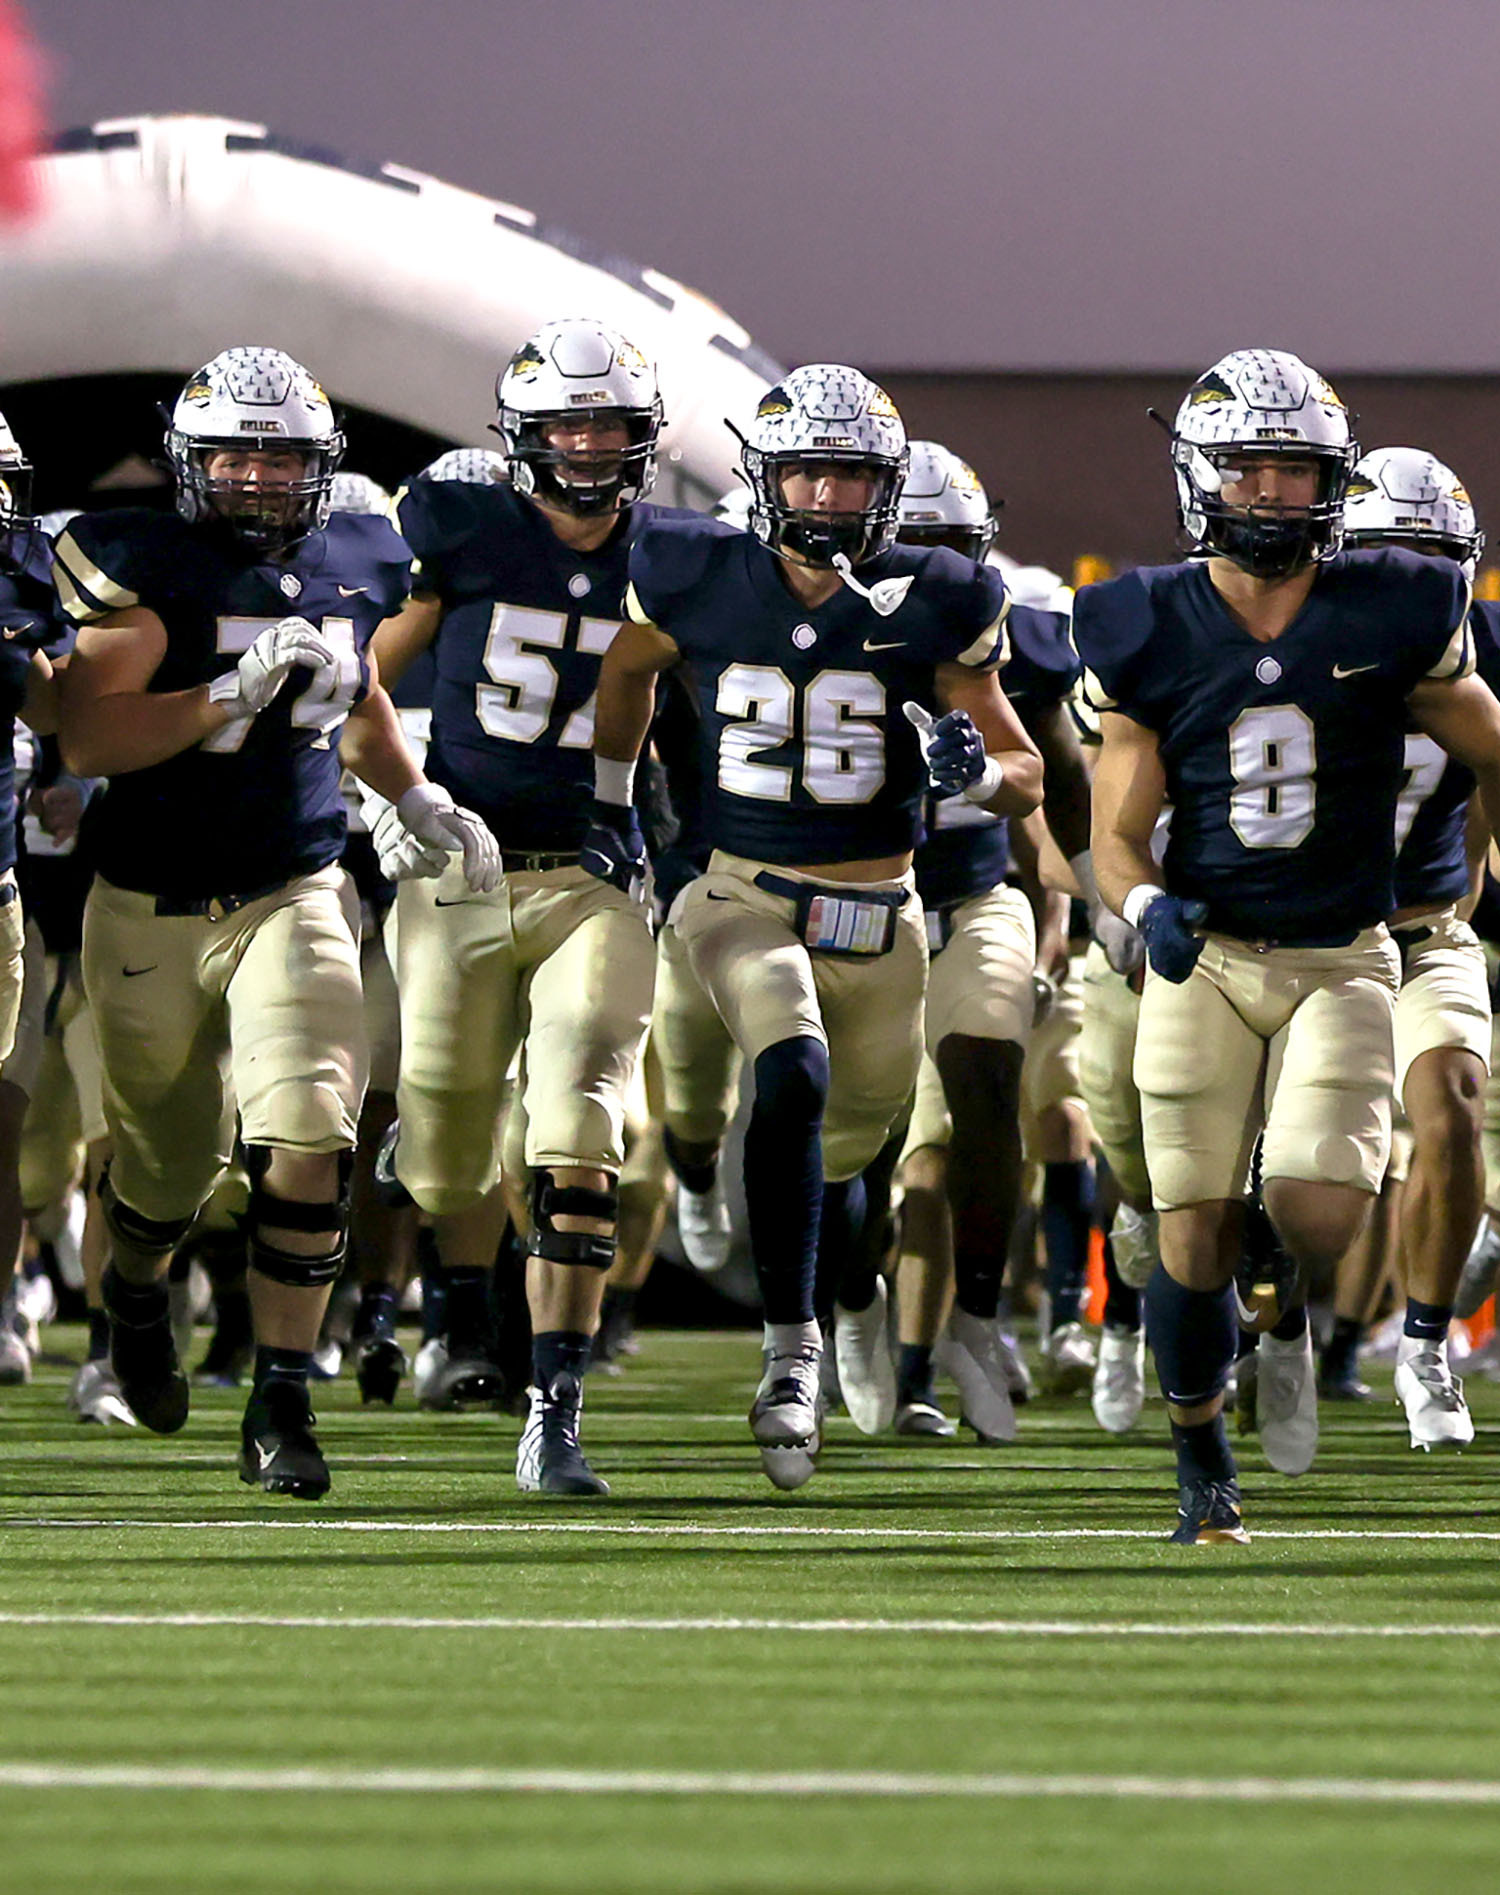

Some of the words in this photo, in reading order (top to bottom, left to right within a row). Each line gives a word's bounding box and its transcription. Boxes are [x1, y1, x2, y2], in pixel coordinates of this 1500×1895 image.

[475, 602, 624, 749] 57
[716, 662, 886, 805] 26
[1228, 704, 1317, 849] 8
